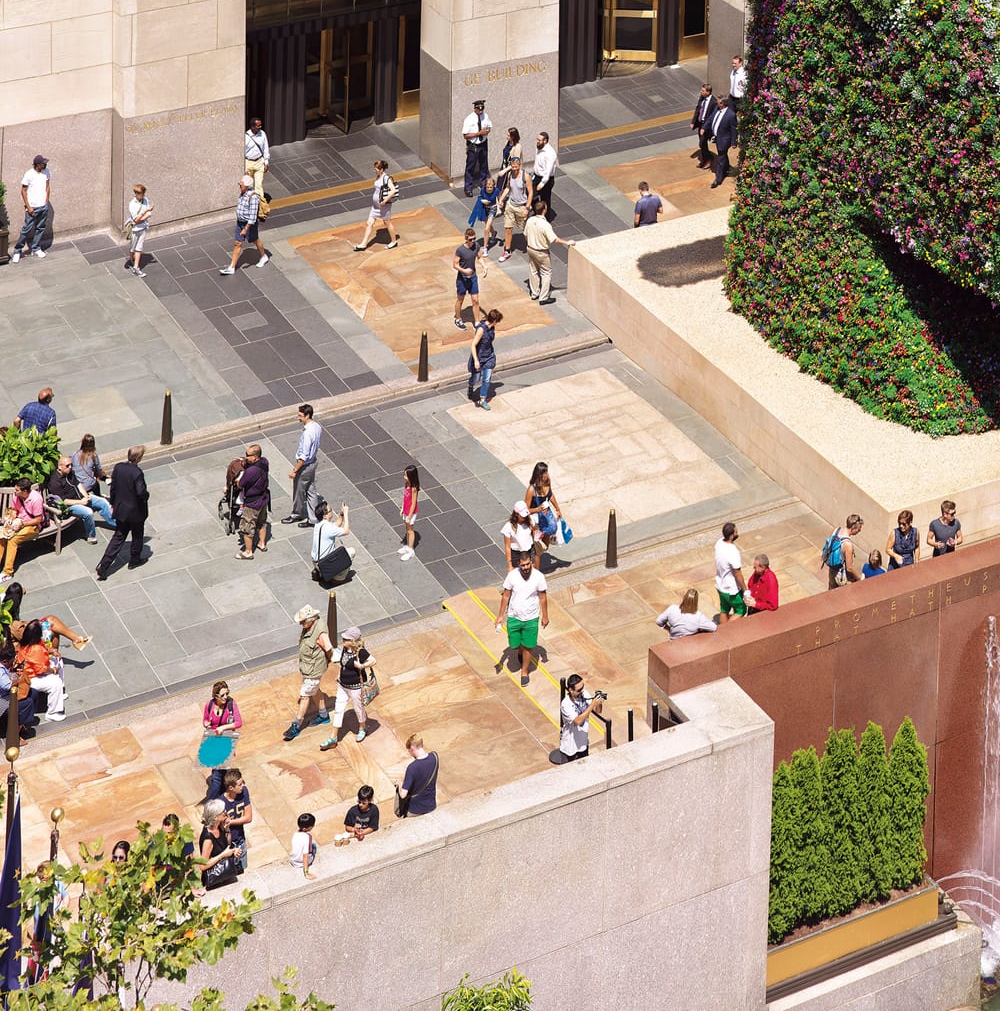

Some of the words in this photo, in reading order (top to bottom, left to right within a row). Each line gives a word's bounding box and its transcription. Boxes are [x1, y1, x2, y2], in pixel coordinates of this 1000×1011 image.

[463, 72, 481, 87] GE
[487, 59, 547, 83] BUILDING
[795, 625, 859, 654] THAT
[890, 596, 952, 623] HATH
[815, 571, 989, 635] PROMETHEUS
